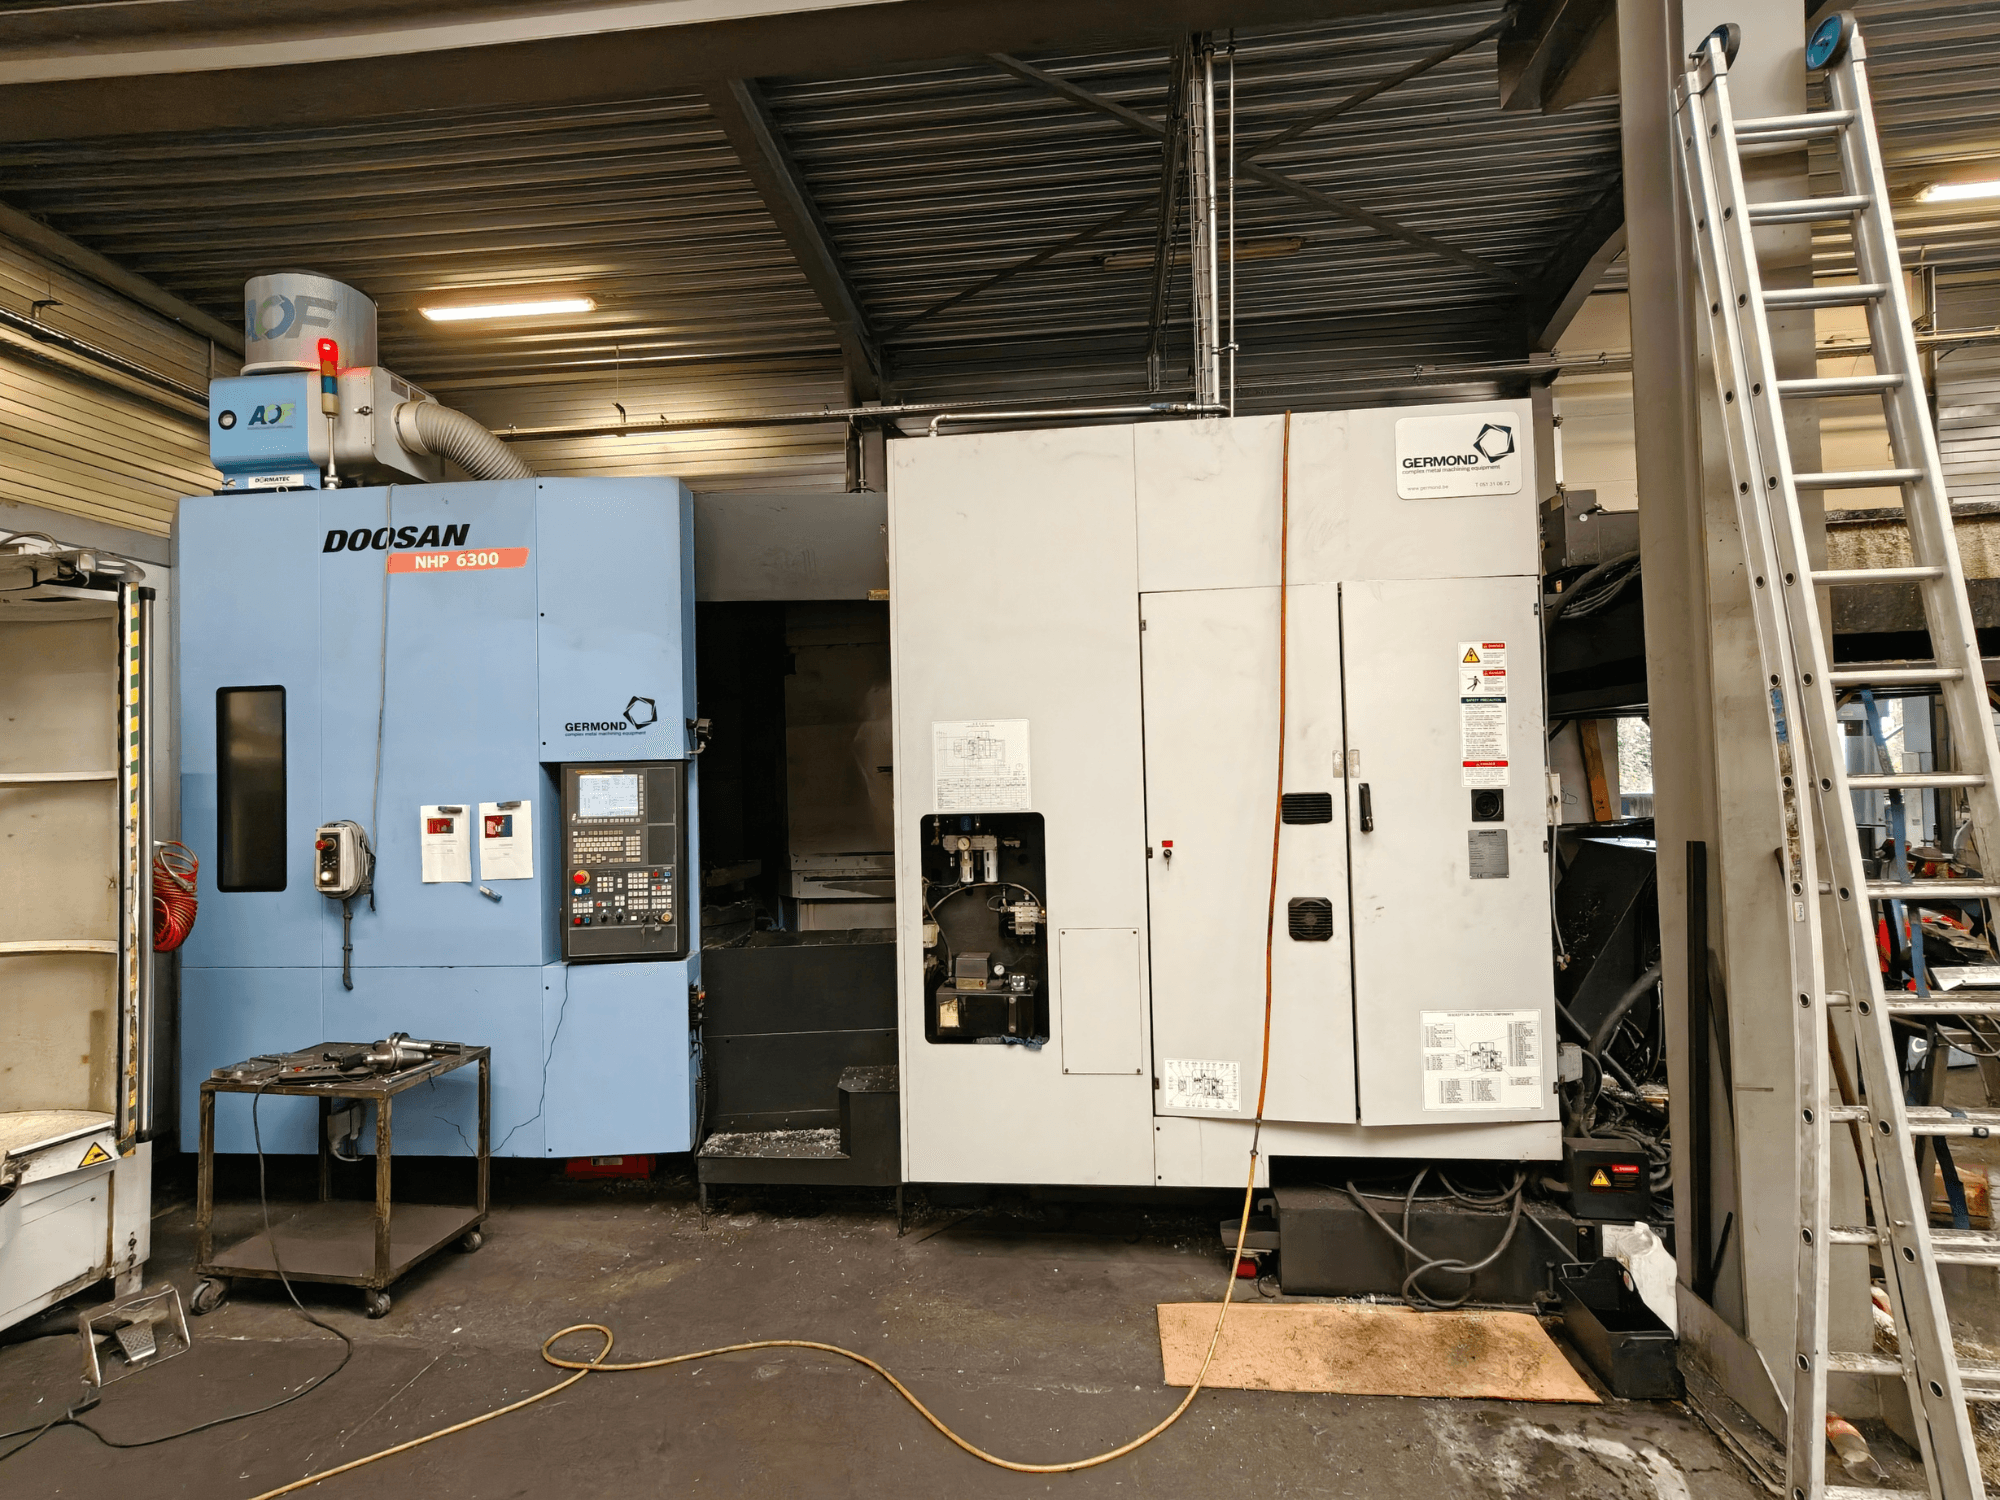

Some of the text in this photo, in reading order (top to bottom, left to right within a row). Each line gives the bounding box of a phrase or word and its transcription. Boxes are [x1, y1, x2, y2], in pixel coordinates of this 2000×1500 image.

[248, 403, 295, 426] AOF
[1402, 454, 1479, 469] GERMOND
[1407, 484, 1449, 492] www.germond.be
[322, 523, 471, 553] DOOSAN
[415, 551, 499, 569] NHP 6300
[565, 721, 627, 732] GERMOND
